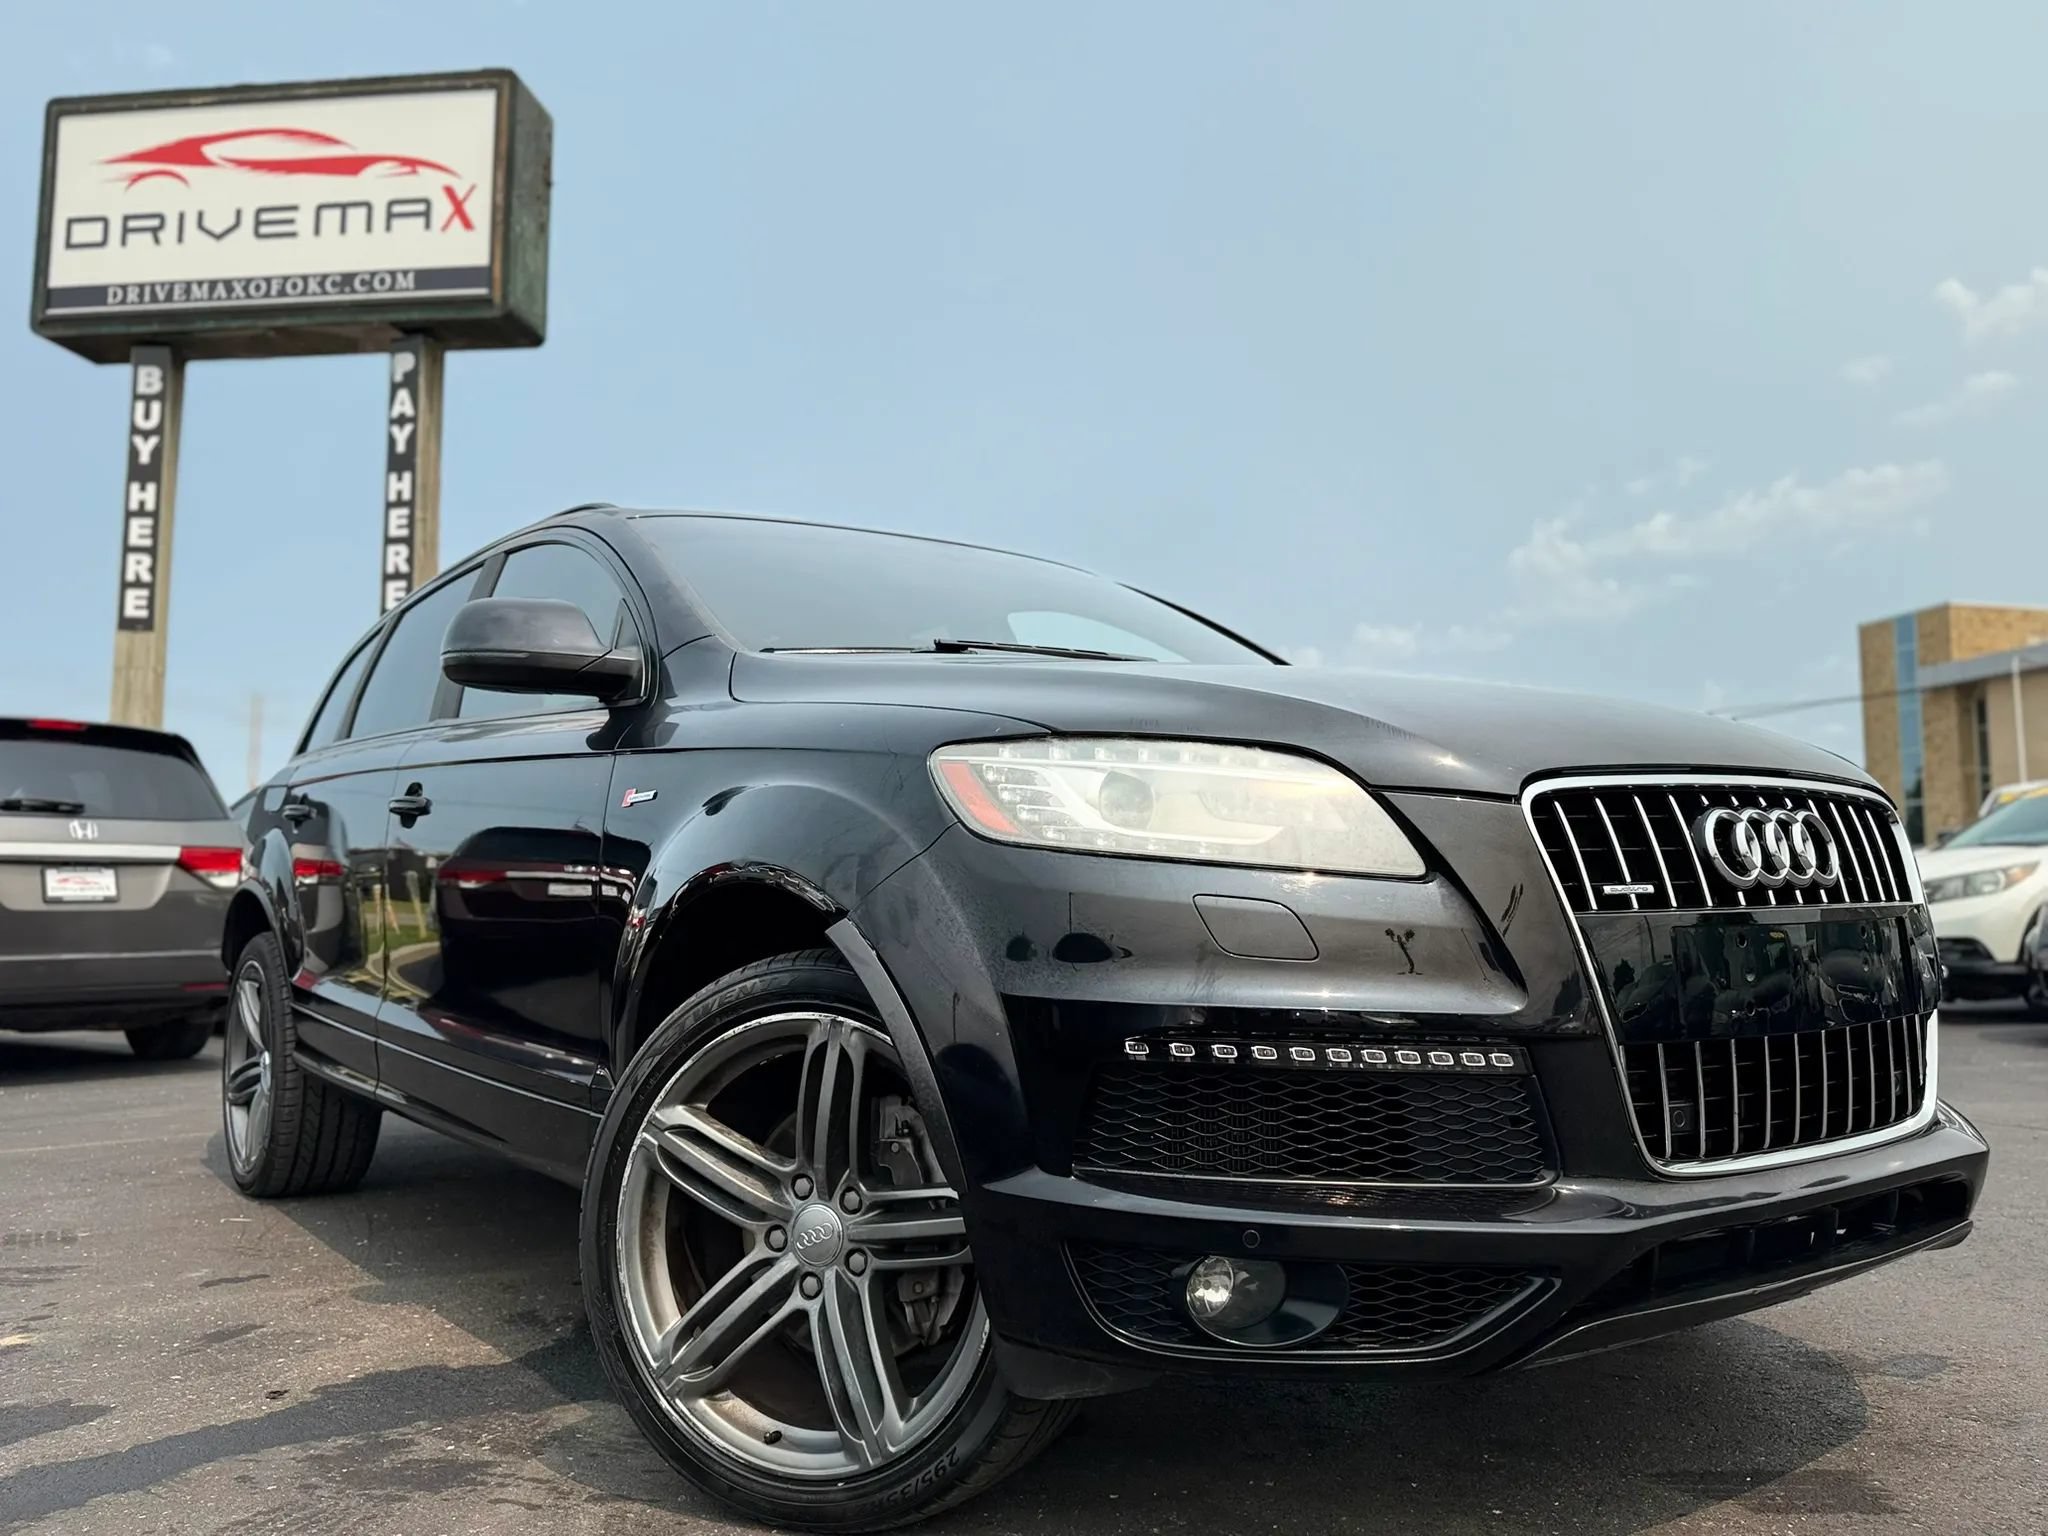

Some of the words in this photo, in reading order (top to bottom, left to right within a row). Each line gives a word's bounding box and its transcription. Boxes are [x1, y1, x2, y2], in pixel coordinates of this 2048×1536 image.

[64, 183, 478, 251] DRIVEMAX
[106, 269, 417, 306] DRIVEMAXOFOKC.COM
[130, 363, 164, 465] BUY
[389, 351, 417, 454] PAY
[122, 480, 158, 619] HERE
[384, 470, 413, 611] HERE
